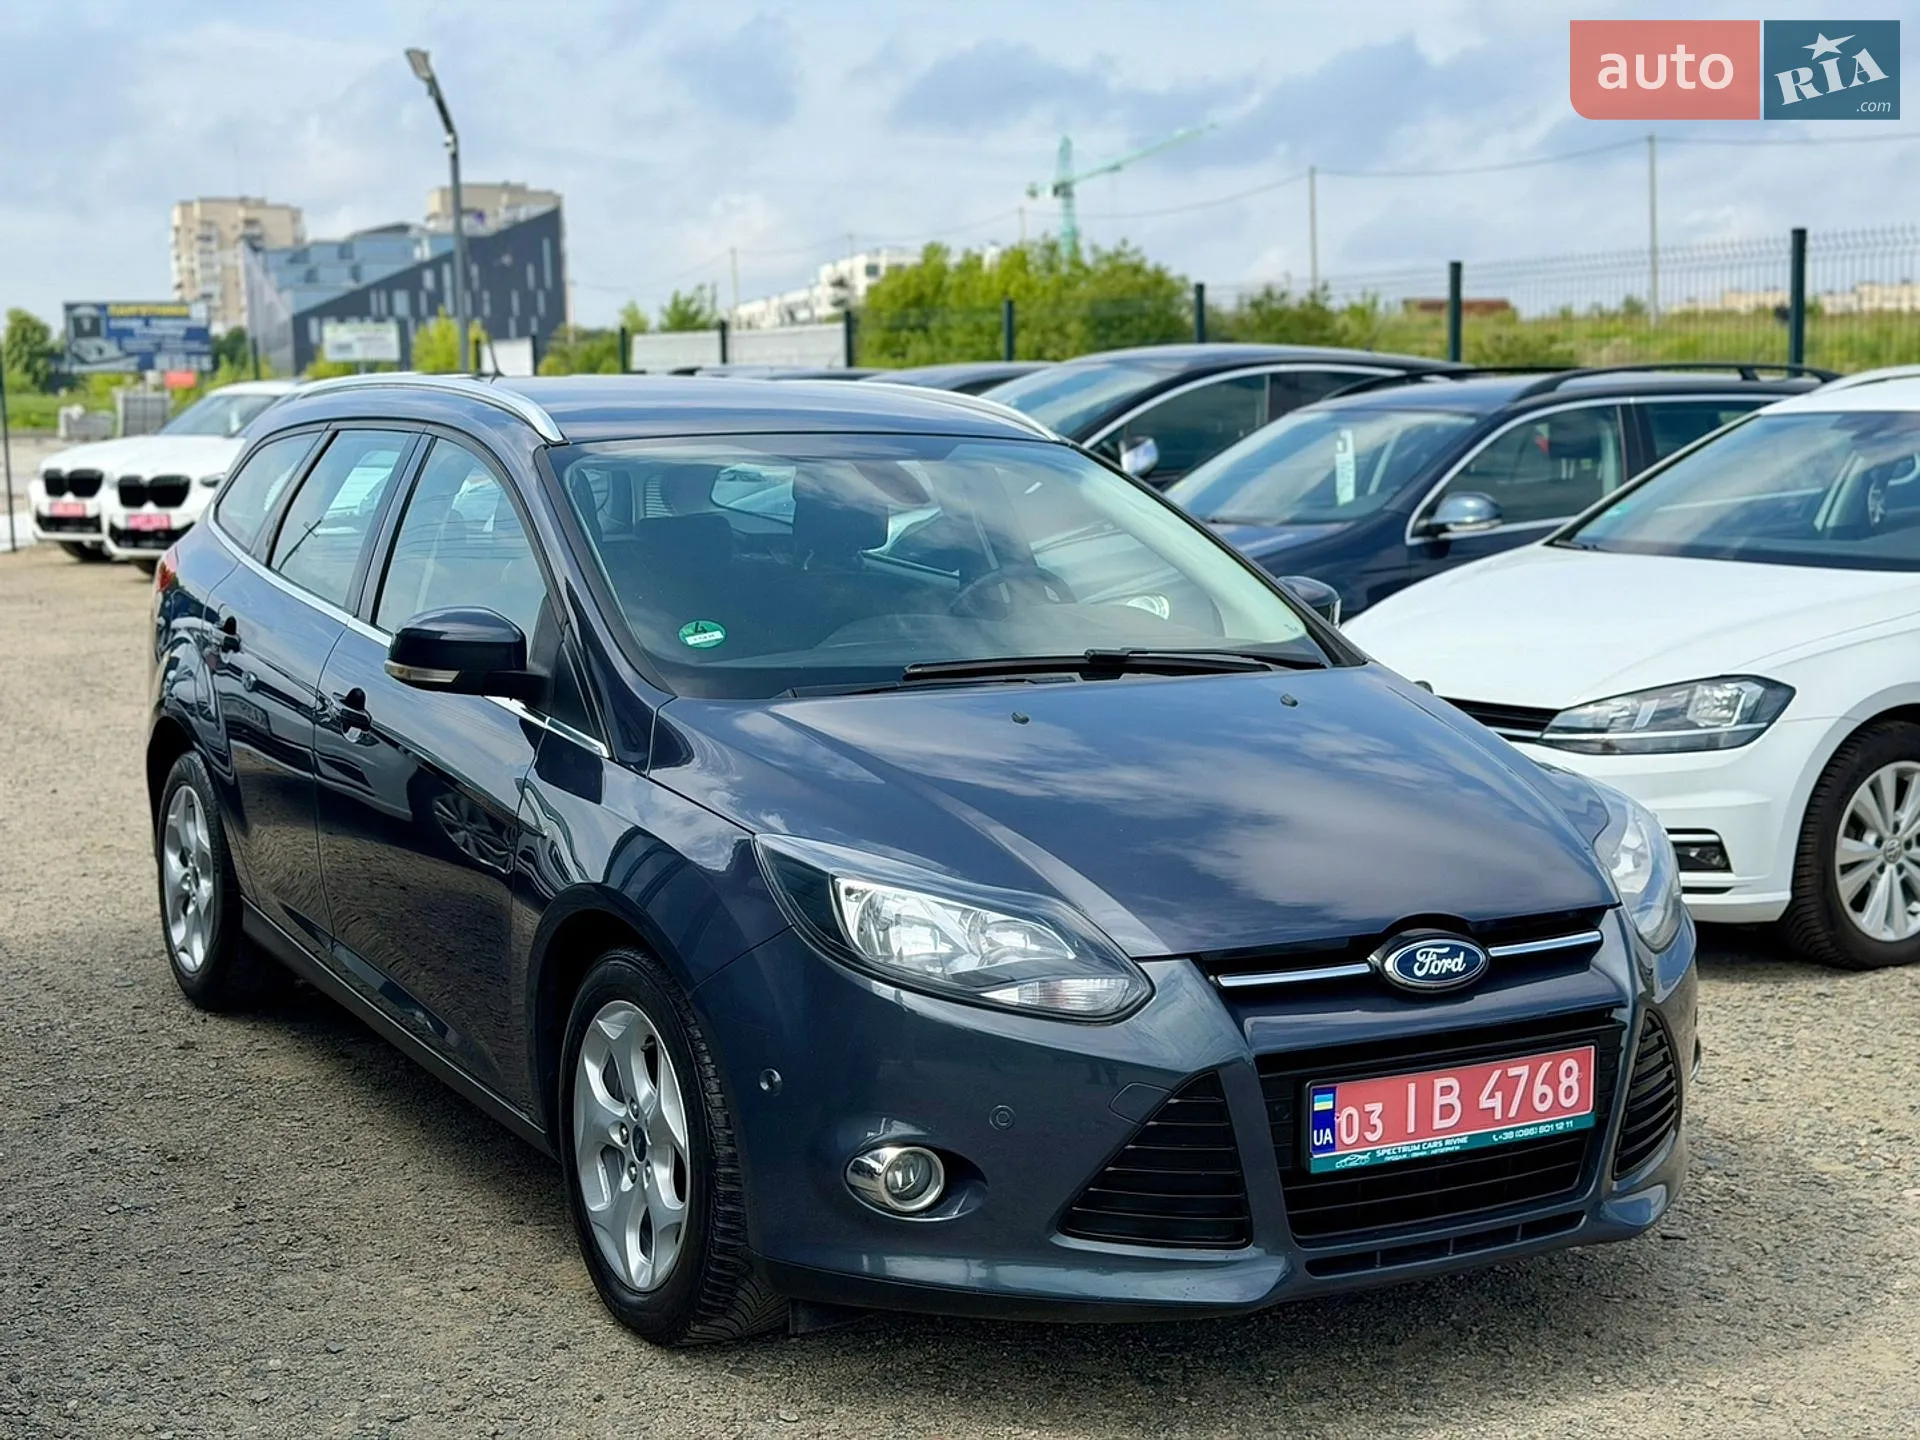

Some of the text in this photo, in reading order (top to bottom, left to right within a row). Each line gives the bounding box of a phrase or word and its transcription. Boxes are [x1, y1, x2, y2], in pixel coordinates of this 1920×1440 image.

[1413, 946, 1467, 977] Ford
[1340, 1102, 1384, 1146] 03
[1479, 1058, 1580, 1121] 4768
[1313, 1128, 1334, 1146] UA
[1376, 1143, 1420, 1157] SPECTRUM
[1422, 1139, 1443, 1150] CARS
